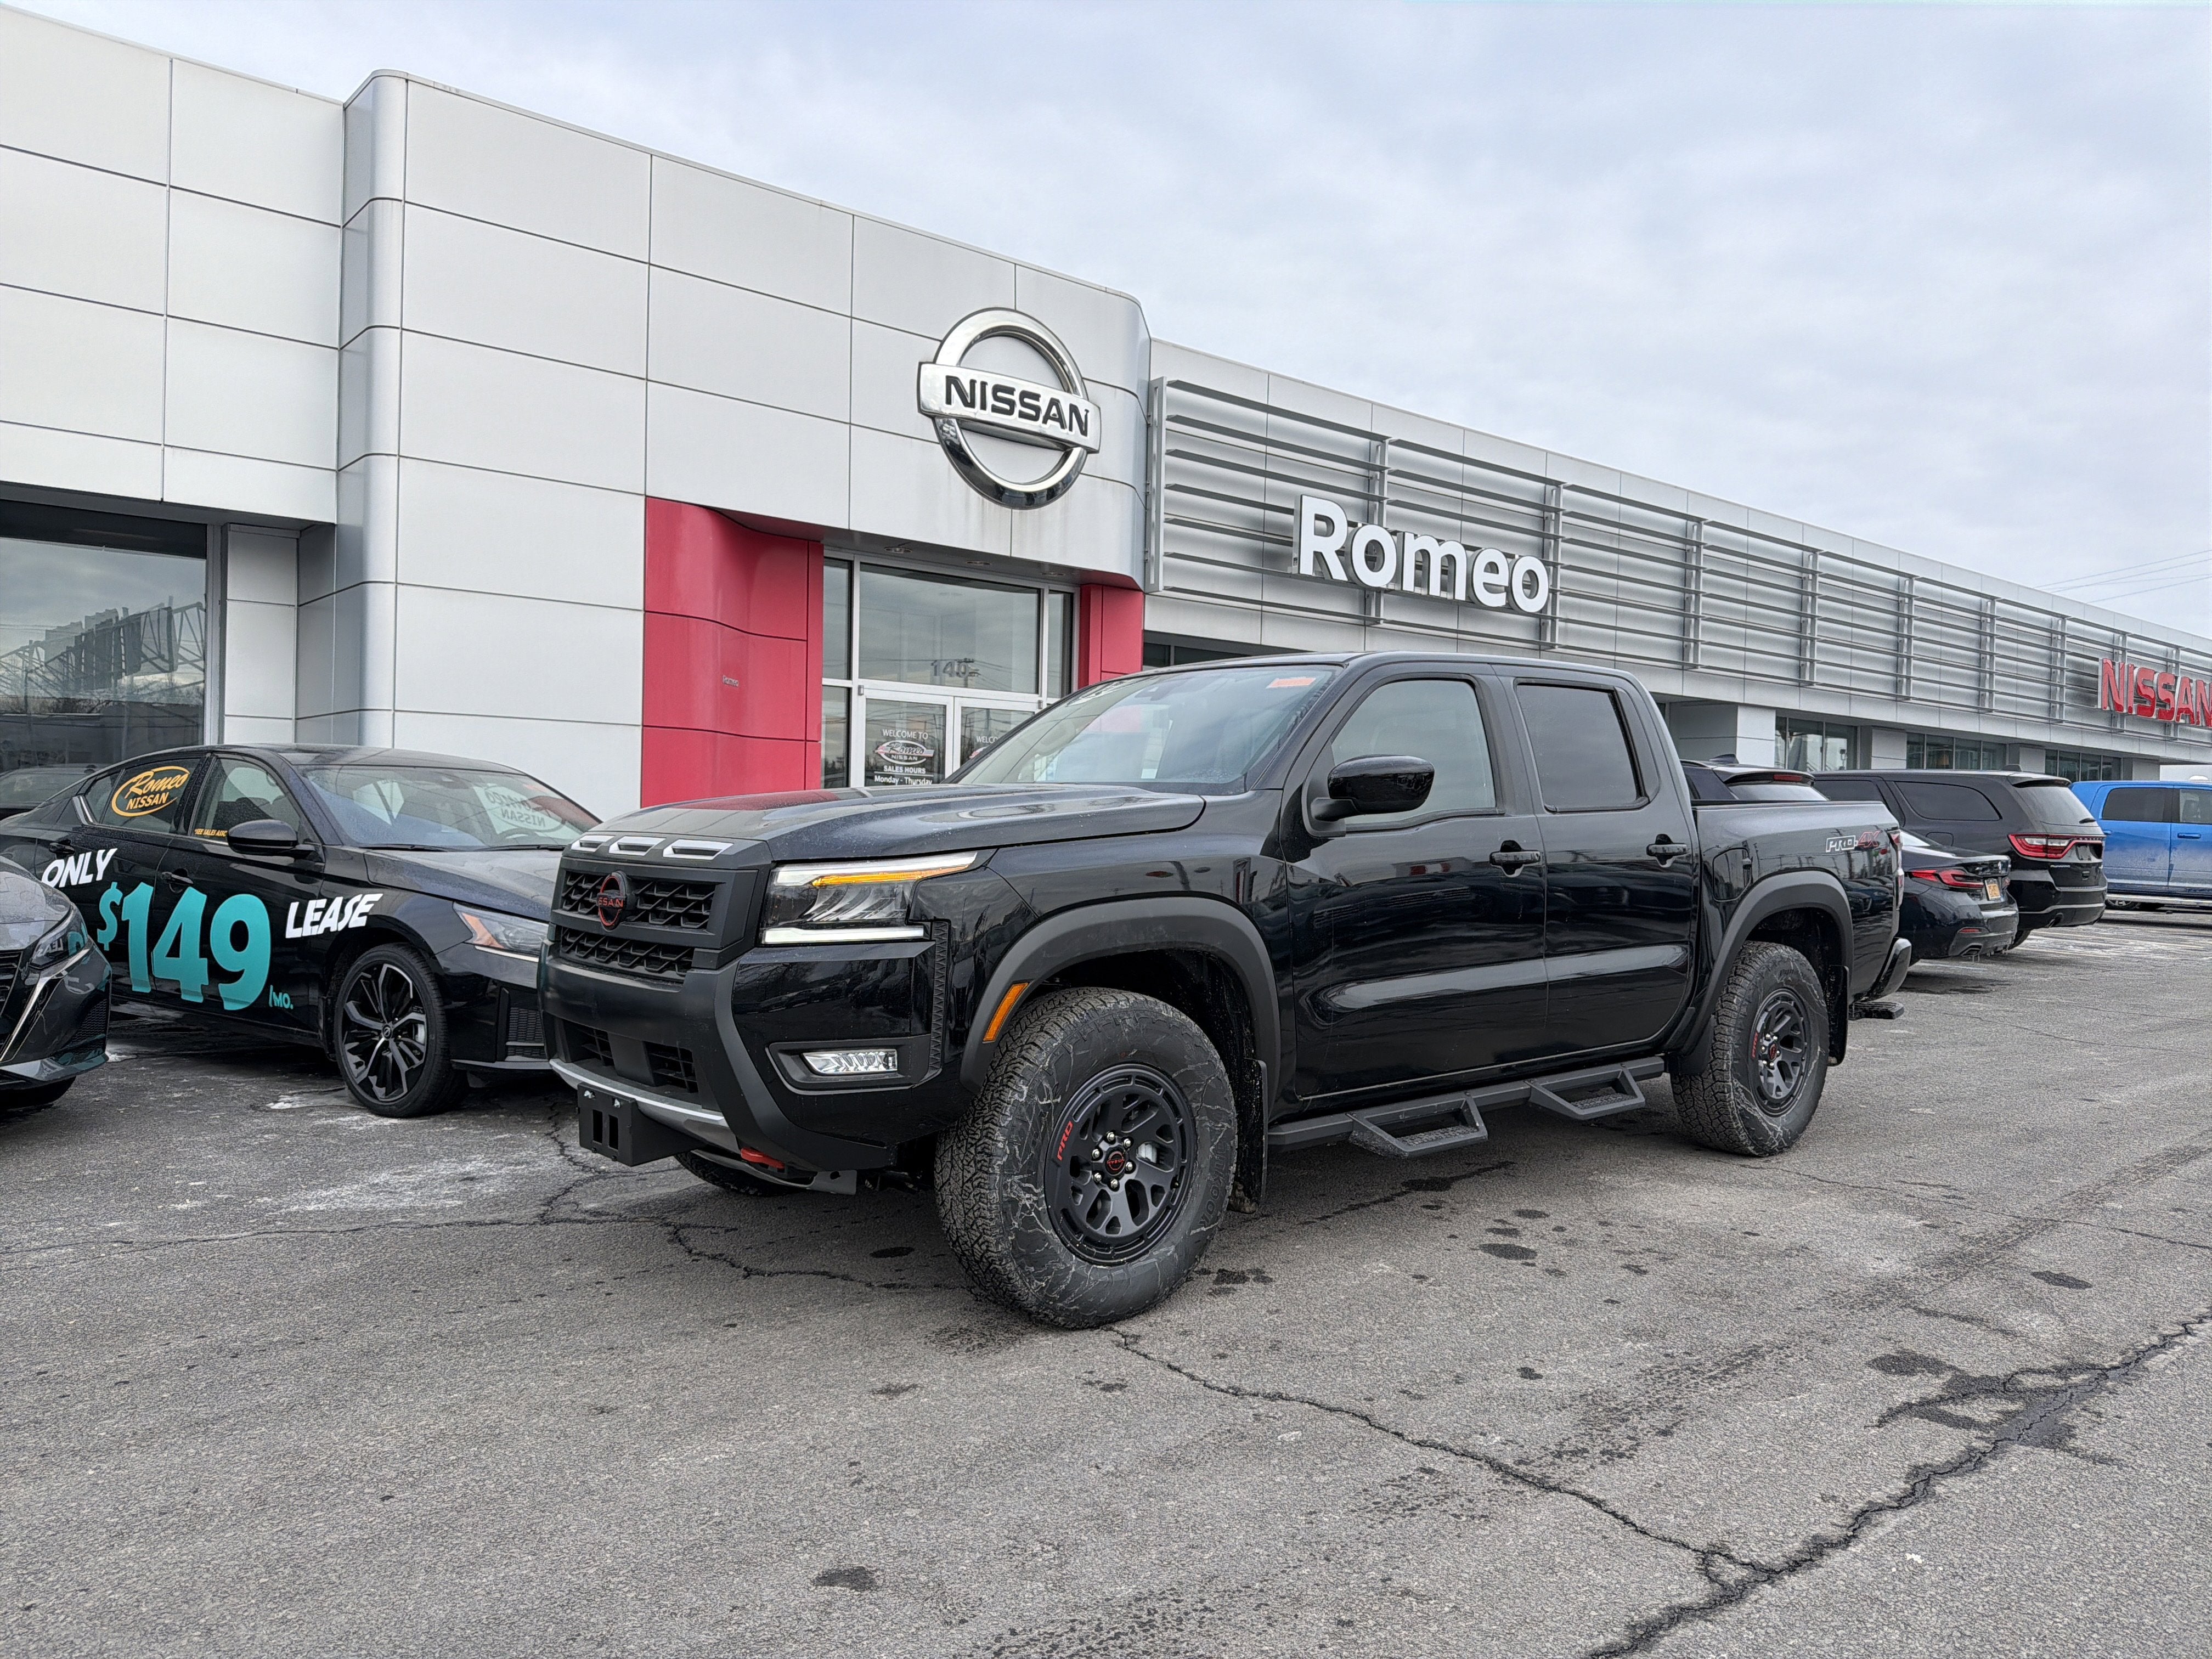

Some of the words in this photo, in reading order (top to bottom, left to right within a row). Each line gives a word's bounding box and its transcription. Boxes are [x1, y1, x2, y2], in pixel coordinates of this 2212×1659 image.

[944, 374, 1090, 438] NISSAN
[1293, 494, 1549, 613] Romeo
[2100, 658, 2212, 729] NISSAN
[882, 729, 918, 739] WELCOME
[918, 731, 928, 740] TO
[885, 741, 925, 755] Romeo
[976, 736, 1000, 744] WELCO
[124, 770, 190, 799] Romeo
[874, 775, 900, 786] Monday
[904, 776, 933, 786] Thursday
[126, 792, 170, 811] NISSAN
[41, 848, 118, 888] ONLY
[285, 893, 383, 939] LEASE
[97, 882, 271, 1010] $149
